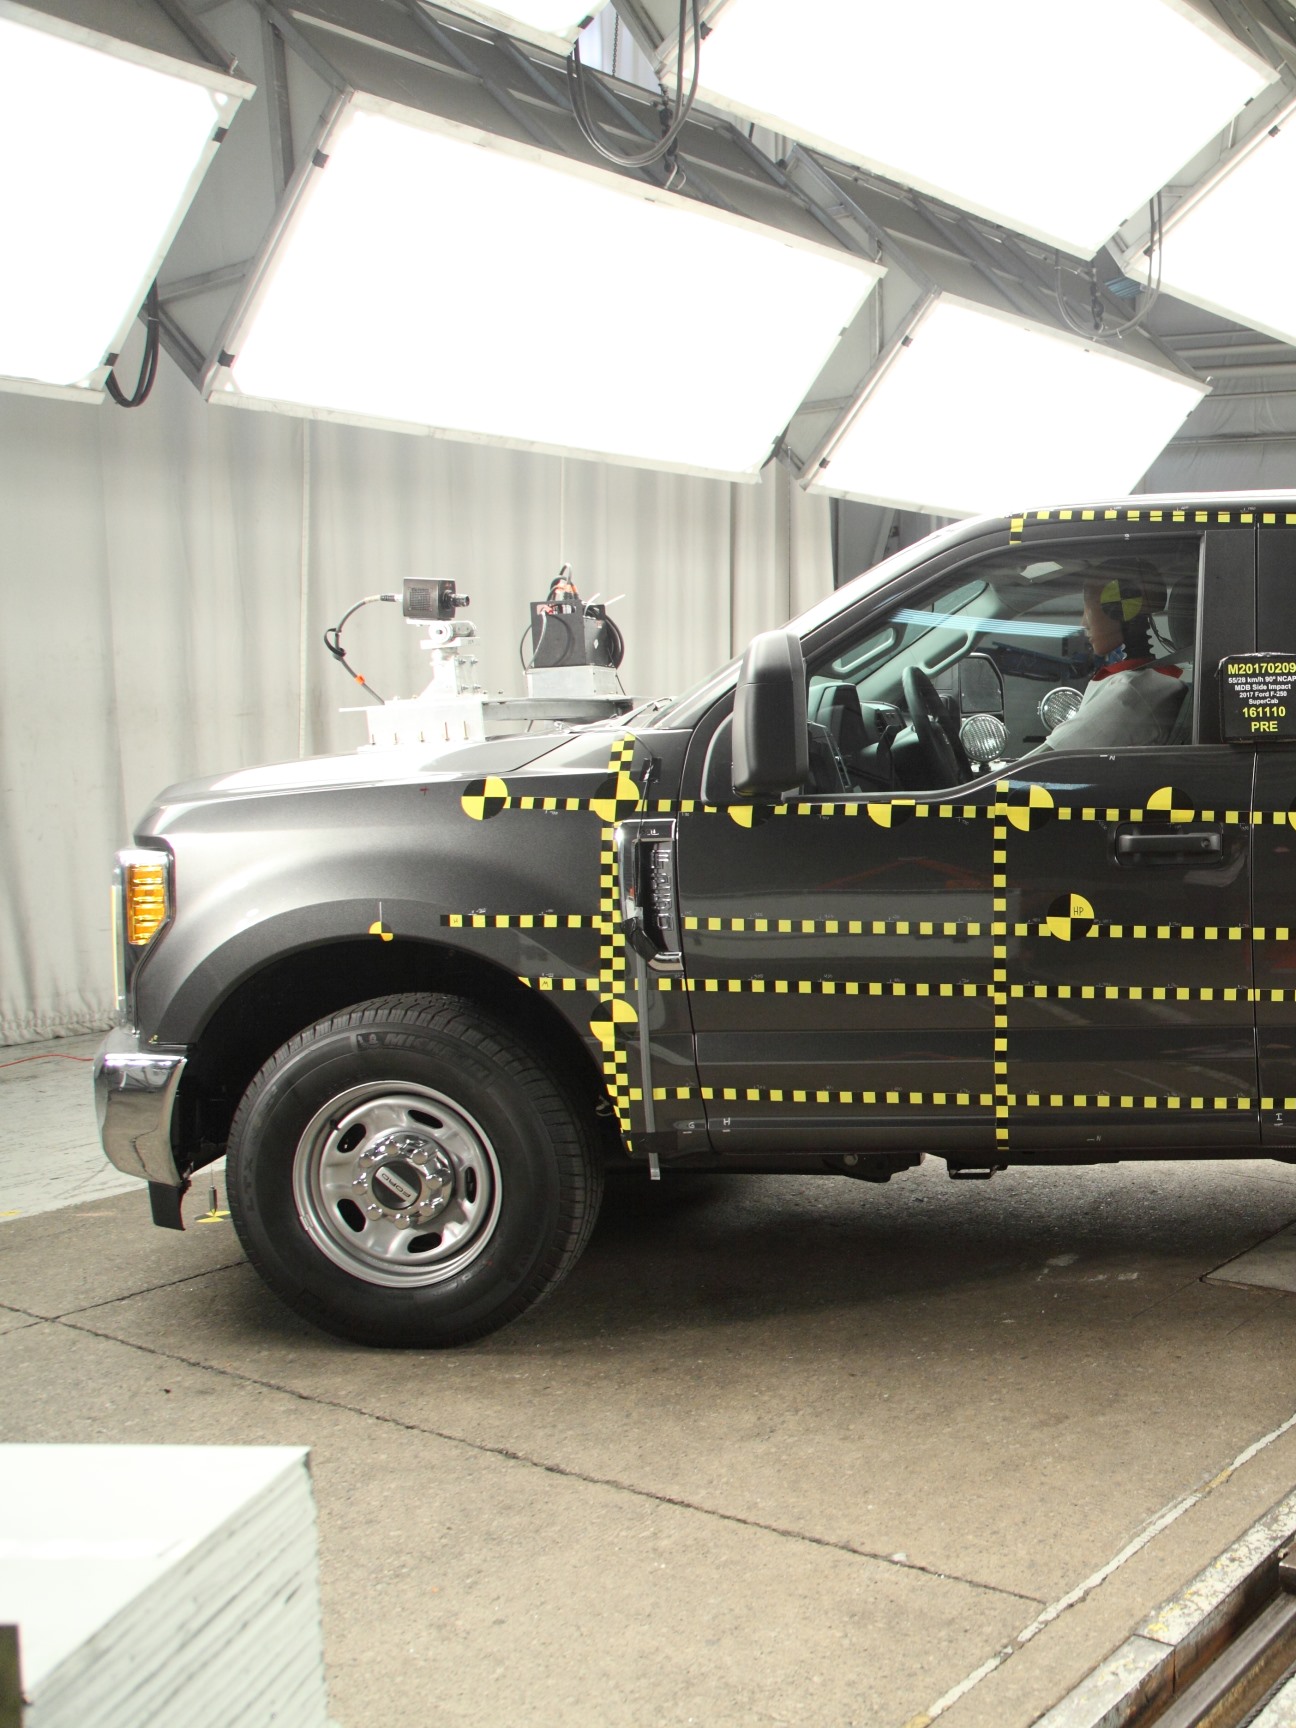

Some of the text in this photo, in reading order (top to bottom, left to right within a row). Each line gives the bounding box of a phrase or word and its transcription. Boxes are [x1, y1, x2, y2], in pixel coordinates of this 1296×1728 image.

[1227, 662, 1296, 675] M20170209
[1228, 676, 1246, 684] 55/28
[1268, 683, 1291, 691] Impact
[1242, 706, 1286, 718] 161110
[1251, 721, 1278, 732] PRE
[1073, 906, 1084, 916] HP
[381, 1172, 411, 1198] FORD
